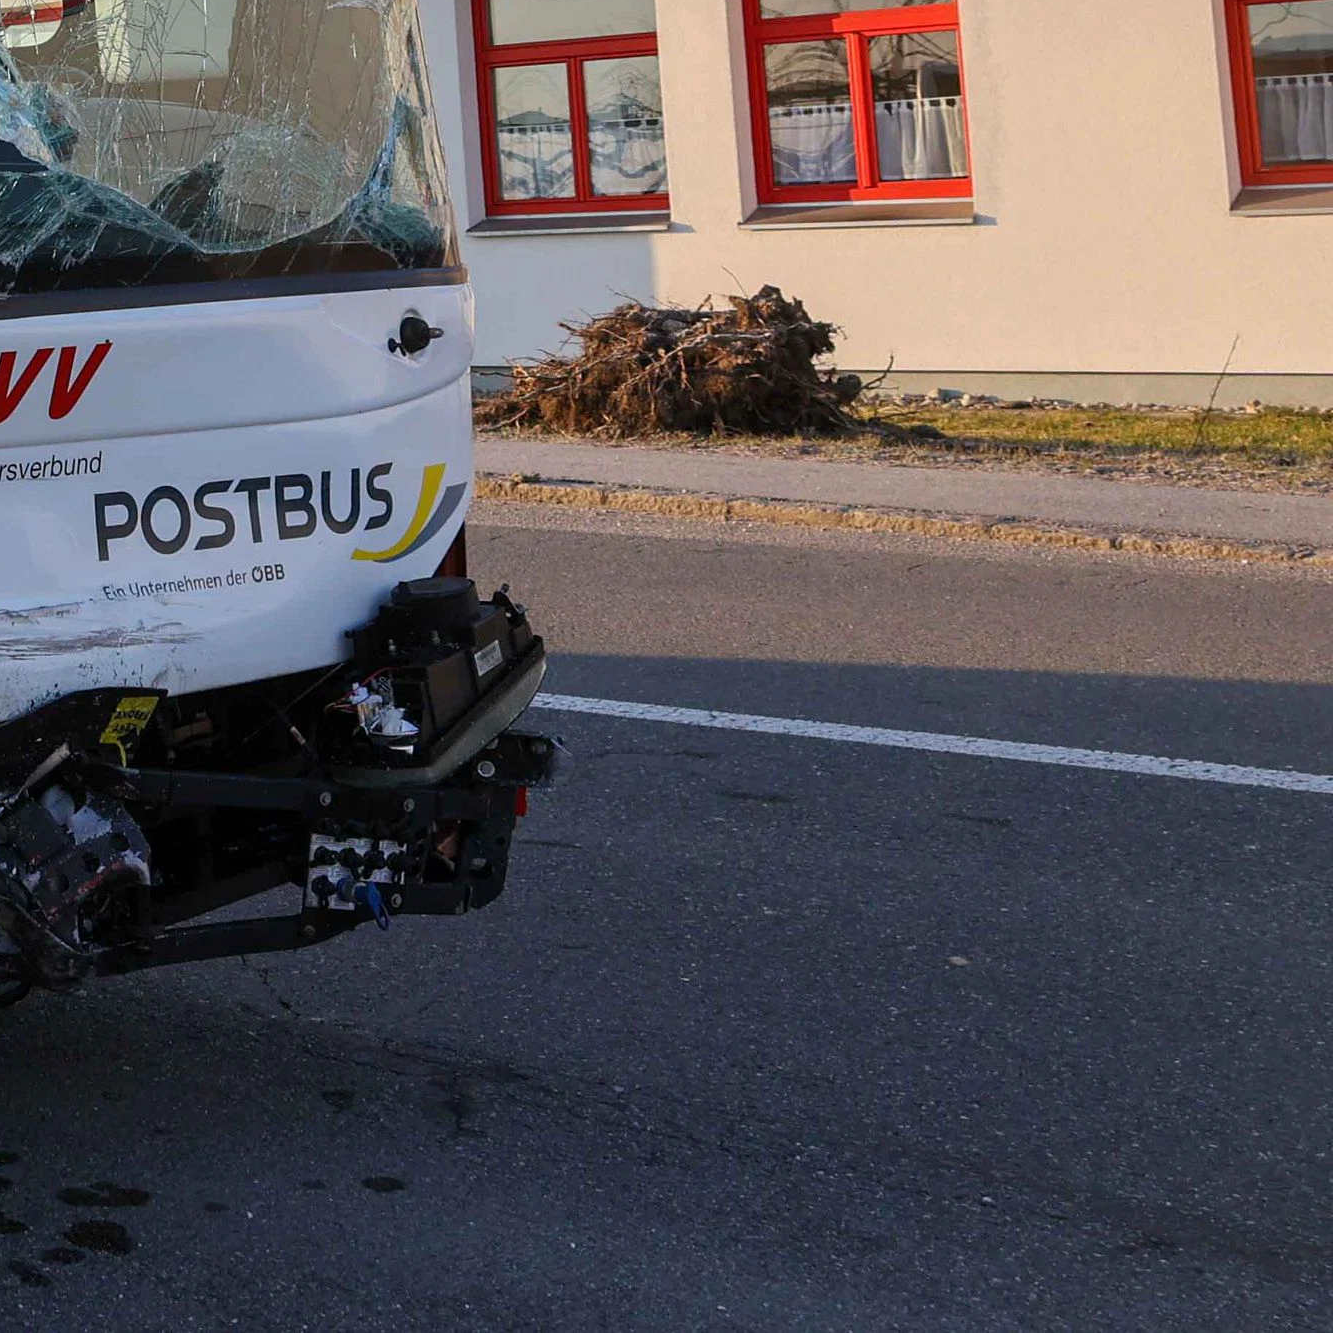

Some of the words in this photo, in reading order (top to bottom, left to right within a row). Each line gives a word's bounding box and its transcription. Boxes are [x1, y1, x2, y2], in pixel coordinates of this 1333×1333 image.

[93, 462, 393, 562] POSTBUS
[103, 585, 126, 601] Ein
[128, 575, 222, 598] Unternehmen
[226, 568, 247, 586] der
[251, 563, 286, 583] ÖBB
